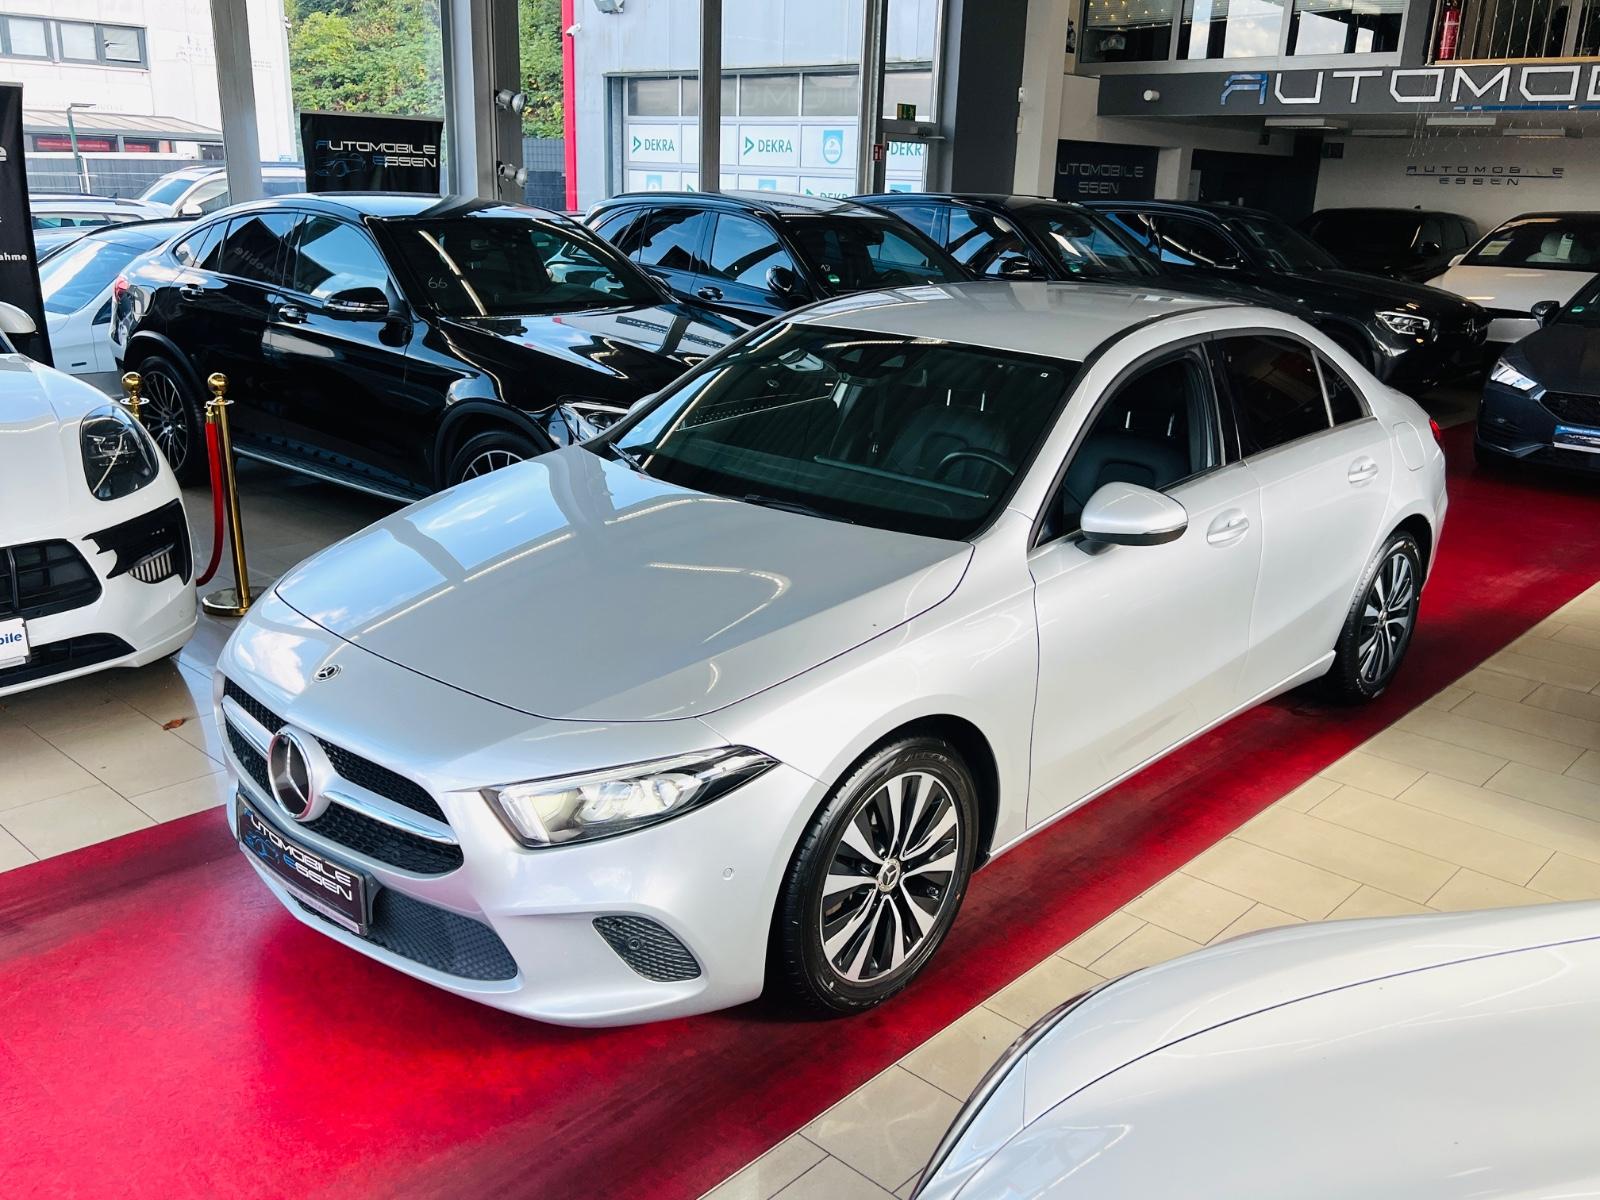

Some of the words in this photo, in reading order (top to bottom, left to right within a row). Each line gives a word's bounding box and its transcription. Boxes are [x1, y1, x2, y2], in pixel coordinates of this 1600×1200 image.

[1220, 66, 1600, 105] AUTOMO
[316, 140, 437, 154] AUTOMOBILE
[644, 138, 675, 152] DEKRA
[758, 139, 793, 153] DEKRA
[372, 155, 437, 168] ESSEN
[1406, 165, 1565, 175] AUTOMOBILE
[1439, 177, 1520, 186] ESSEN
[427, 276, 449, 289] 66
[243, 807, 353, 887] AUTOMOBILE
[282, 853, 353, 902] ESSEN
